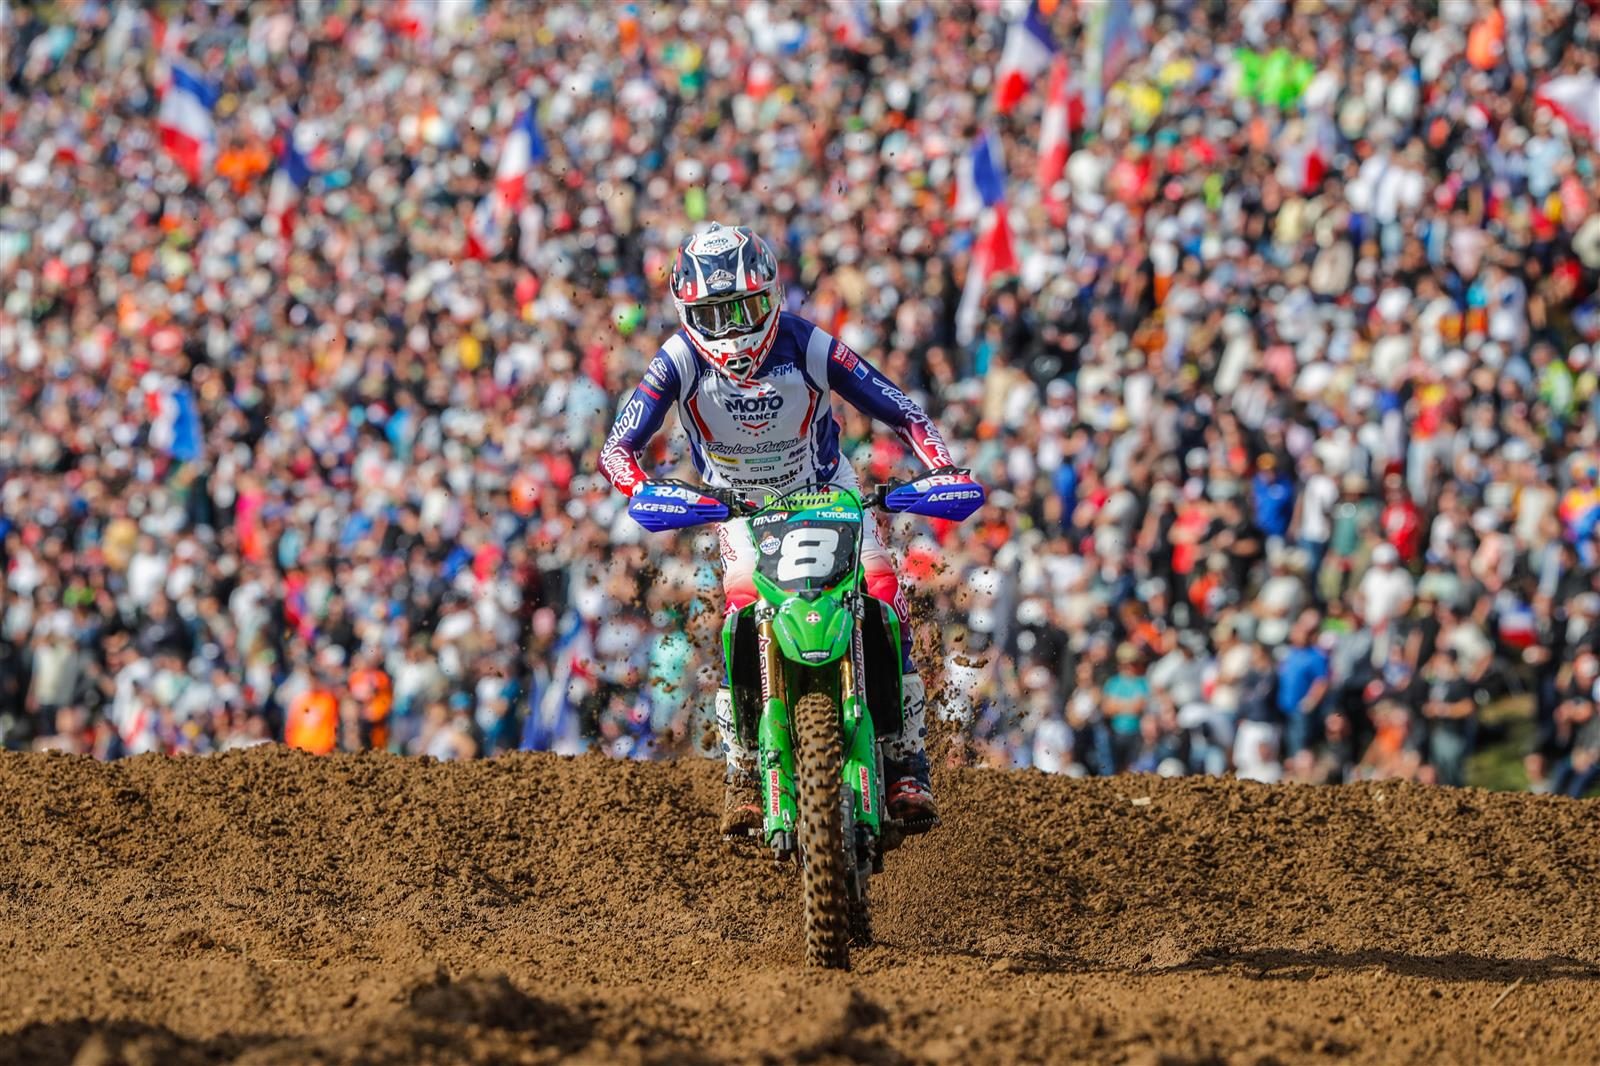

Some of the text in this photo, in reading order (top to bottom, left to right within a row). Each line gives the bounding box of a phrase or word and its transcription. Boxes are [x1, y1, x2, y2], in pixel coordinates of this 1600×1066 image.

[773, 362, 794, 377] FIM
[725, 395, 784, 413] MOTO
[614, 399, 644, 438] Troy
[732, 412, 778, 421] FRANCE
[706, 442, 734, 455] Troy
[731, 443, 756, 455] Lee
[757, 438, 799, 455] Designs
[719, 464, 803, 486] Kawasaki
[928, 490, 981, 502] ACERBIS
[633, 502, 687, 514] ACERBIS
[816, 511, 859, 520] MOTOREX
[777, 528, 839, 581] 8
[770, 770, 779, 816] BRAKING
[860, 768, 870, 813] BRAKING
